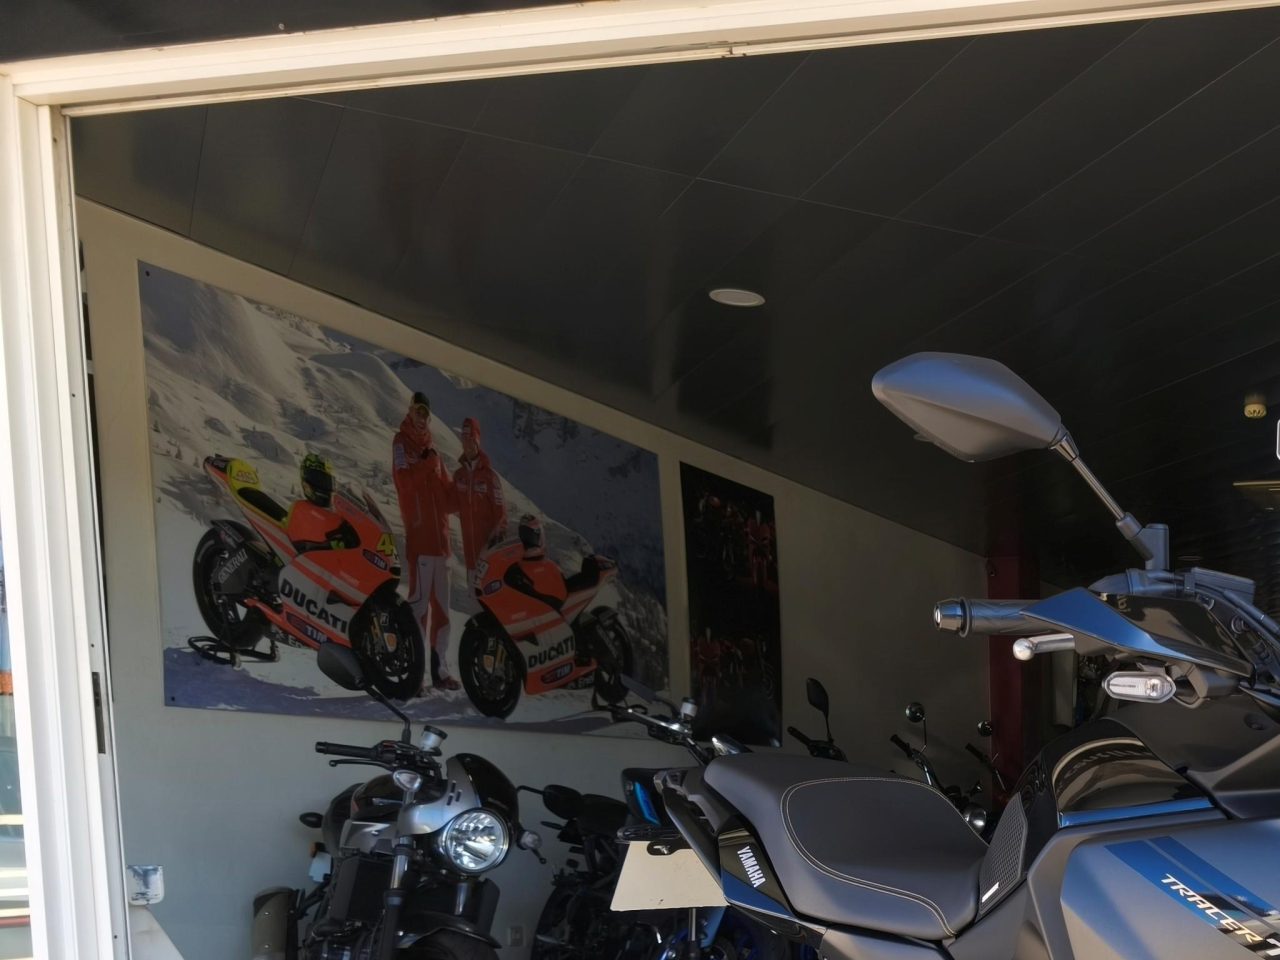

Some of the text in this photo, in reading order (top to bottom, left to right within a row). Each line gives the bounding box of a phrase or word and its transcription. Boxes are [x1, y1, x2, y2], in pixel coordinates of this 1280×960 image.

[280, 577, 349, 635] DUCATI
[528, 635, 575, 668] DUCATI
[737, 845, 767, 888] YAMAHA
[1160, 873, 1265, 943] TRACER
